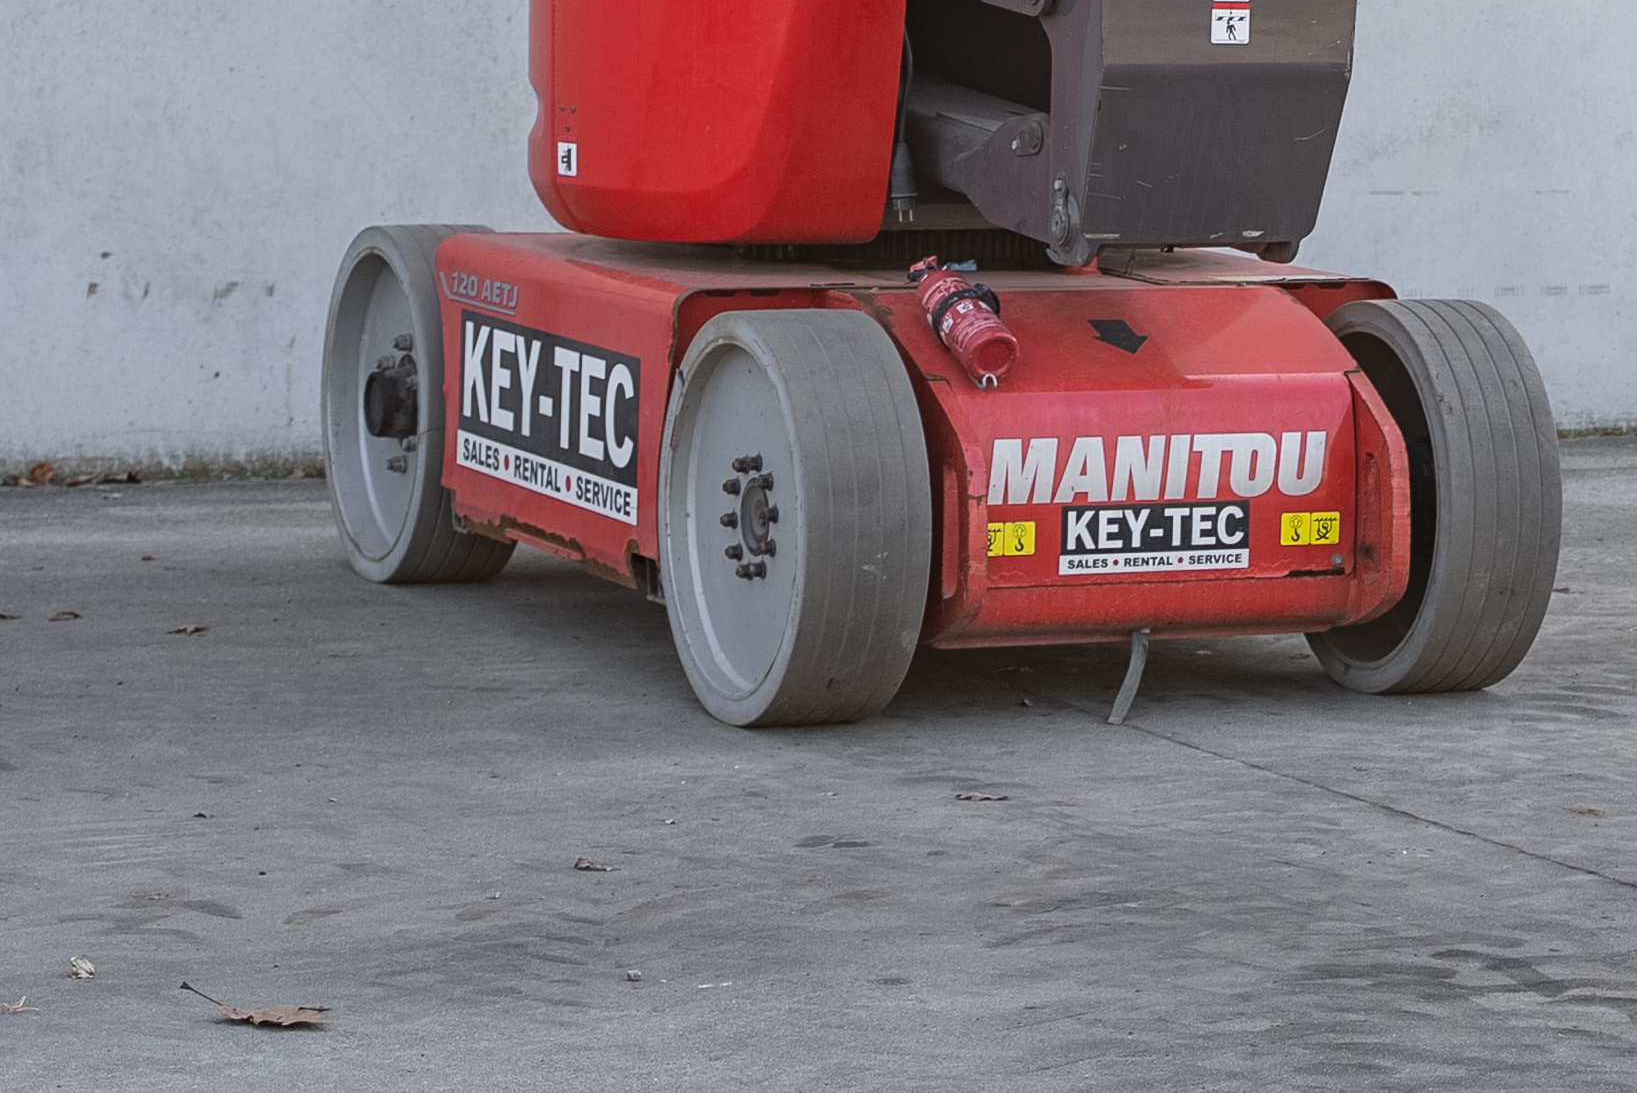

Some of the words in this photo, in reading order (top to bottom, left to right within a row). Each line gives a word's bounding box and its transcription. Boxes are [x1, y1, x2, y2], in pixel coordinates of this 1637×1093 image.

[452, 271, 479, 298] 120
[481, 278, 519, 308] AETJ
[462, 320, 635, 469] KEY-TEC
[463, 438, 500, 471] SALES
[514, 455, 561, 493] RENTAL
[576, 476, 632, 517] SERVICE
[987, 431, 1327, 505] MANITOU
[1067, 506, 1245, 550] KEY-TEC
[1067, 558, 1109, 569] SALES
[1123, 556, 1174, 568] RENTAL
[1188, 554, 1243, 565] SERVICE
